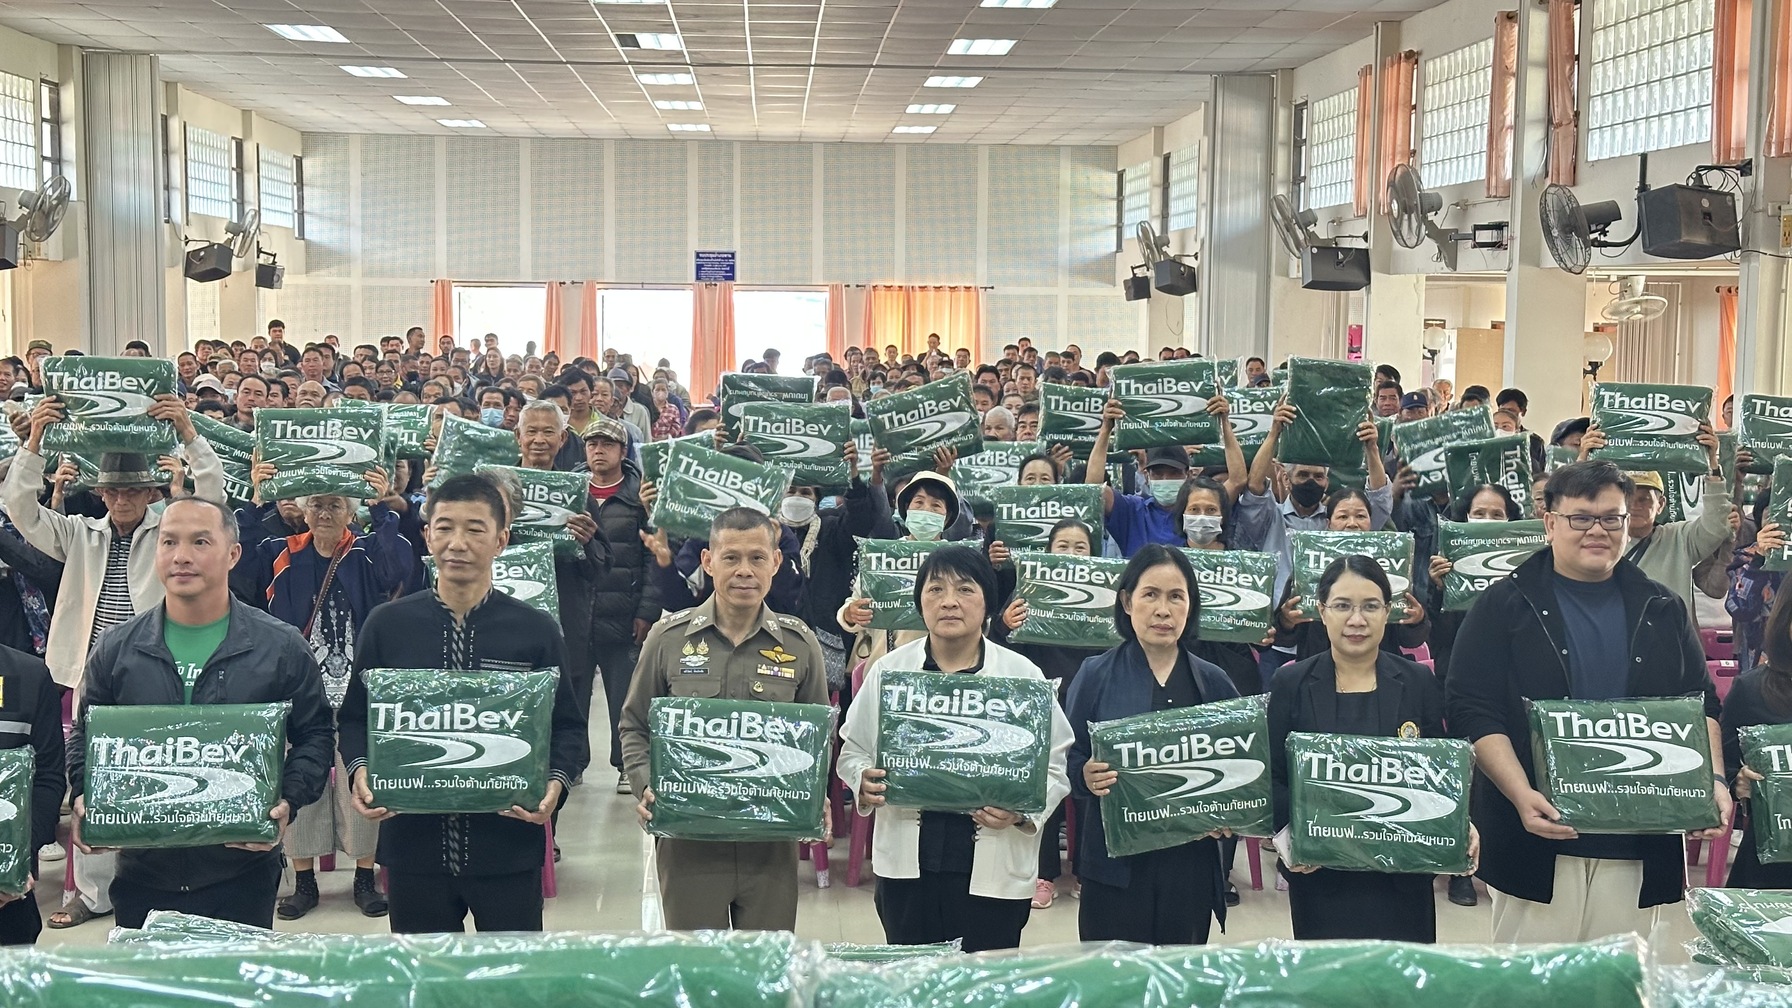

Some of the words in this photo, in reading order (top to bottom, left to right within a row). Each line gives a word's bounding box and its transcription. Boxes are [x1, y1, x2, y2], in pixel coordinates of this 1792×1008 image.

[46, 371, 154, 392] ThaiBev
[1115, 378, 1204, 395] ThaiBev
[880, 396, 962, 430] ThaiBev
[1047, 395, 1104, 412] ThaiB
[1229, 398, 1277, 414] iBev
[1600, 391, 1701, 413] ThaiBev
[271, 420, 374, 441] ThaiBev
[744, 415, 832, 436] ThaiBev
[678, 454, 772, 499] ThaiBev
[522, 484, 577, 505] iBev
[997, 501, 1089, 519] ThaiBev
[1304, 548, 1405, 571] Thev
[1021, 560, 1120, 585] ThaiBev
[1193, 565, 1269, 587] aiBev
[884, 684, 1031, 718] ThaiBev
[370, 702, 525, 731] ThaiBev
[661, 707, 809, 741] ThaiBev
[1548, 711, 1693, 741] ThaiBev
[91, 736, 249, 765] ThaiBev
[1113, 732, 1256, 767] ThaiBev
[1307, 752, 1450, 785] ThaiBev
[1121, 797, 1267, 823] ไทยเบฟ...รวมใจต้านภัยหนาว
